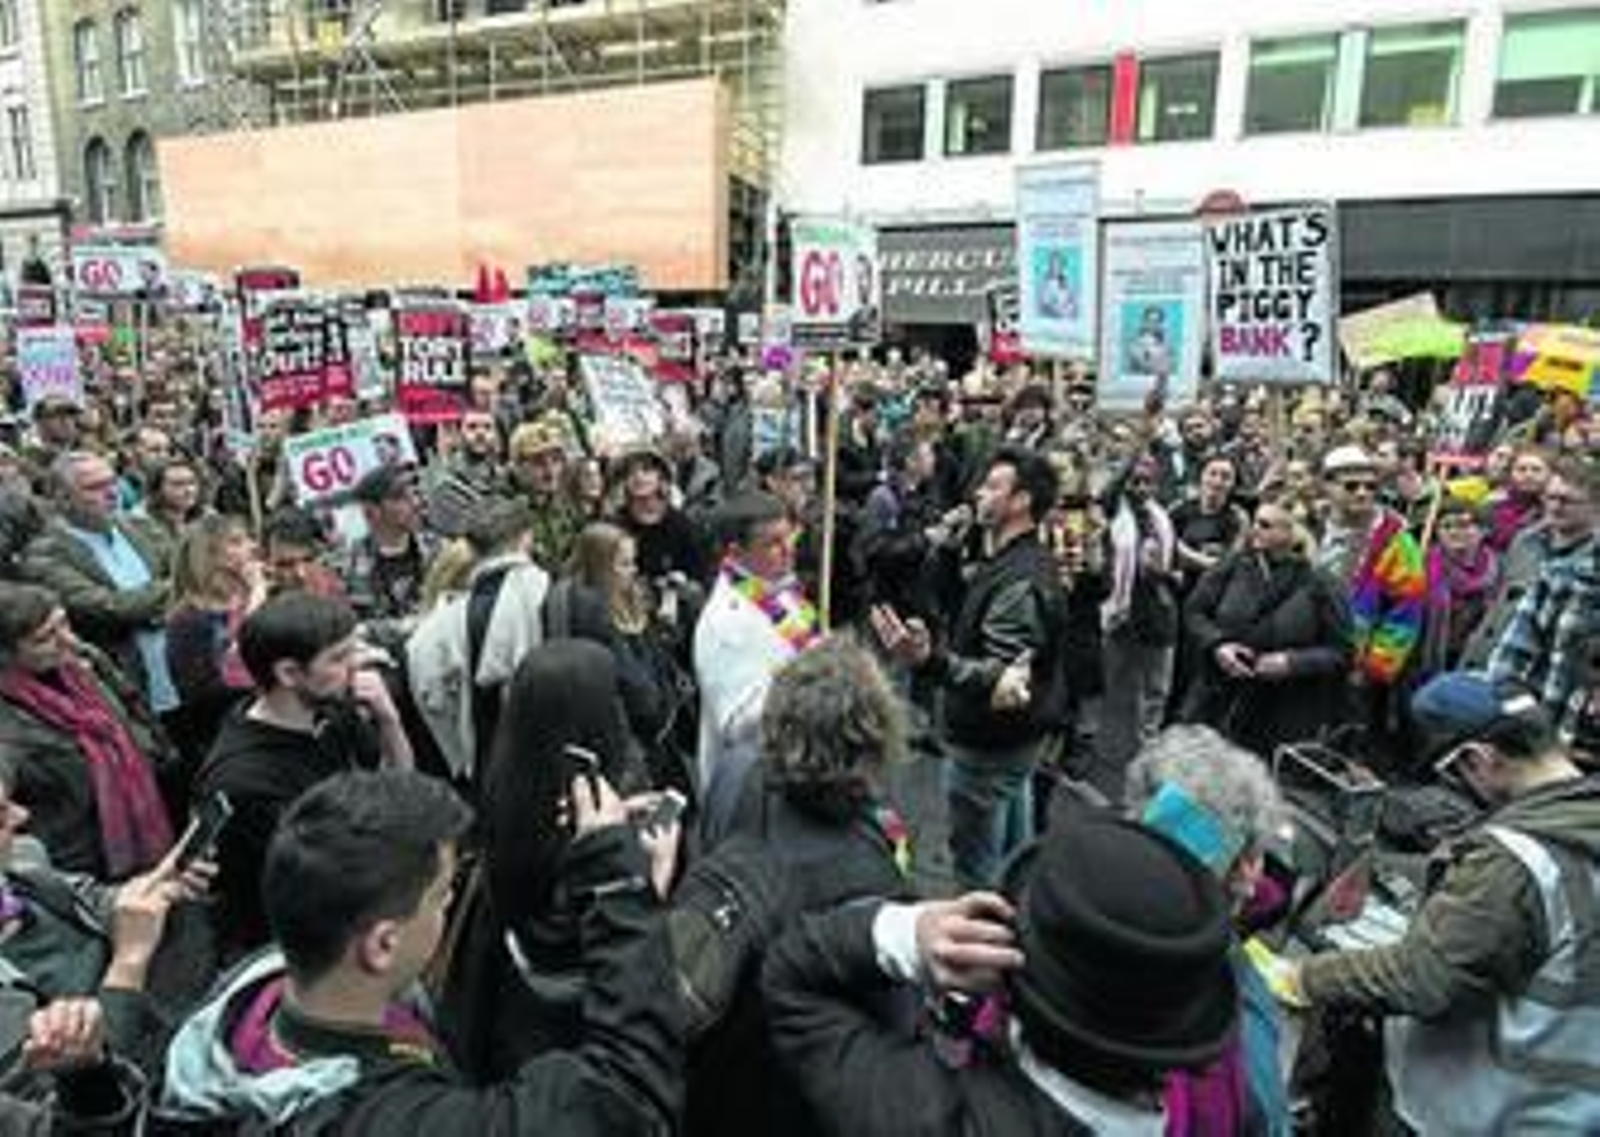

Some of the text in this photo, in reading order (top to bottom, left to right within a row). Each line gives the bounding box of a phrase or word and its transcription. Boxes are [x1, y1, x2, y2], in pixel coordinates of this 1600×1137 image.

[1210, 212, 1328, 253] WHAT'S
[877, 249, 1005, 272] HERCU
[1218, 259, 1250, 290] IN
[1258, 251, 1318, 286] THE
[801, 250, 842, 316] GO
[1216, 289, 1317, 323] PIGGY
[399, 335, 464, 361] TORY
[1220, 325, 1291, 357] BANK
[302, 446, 356, 492] GO
